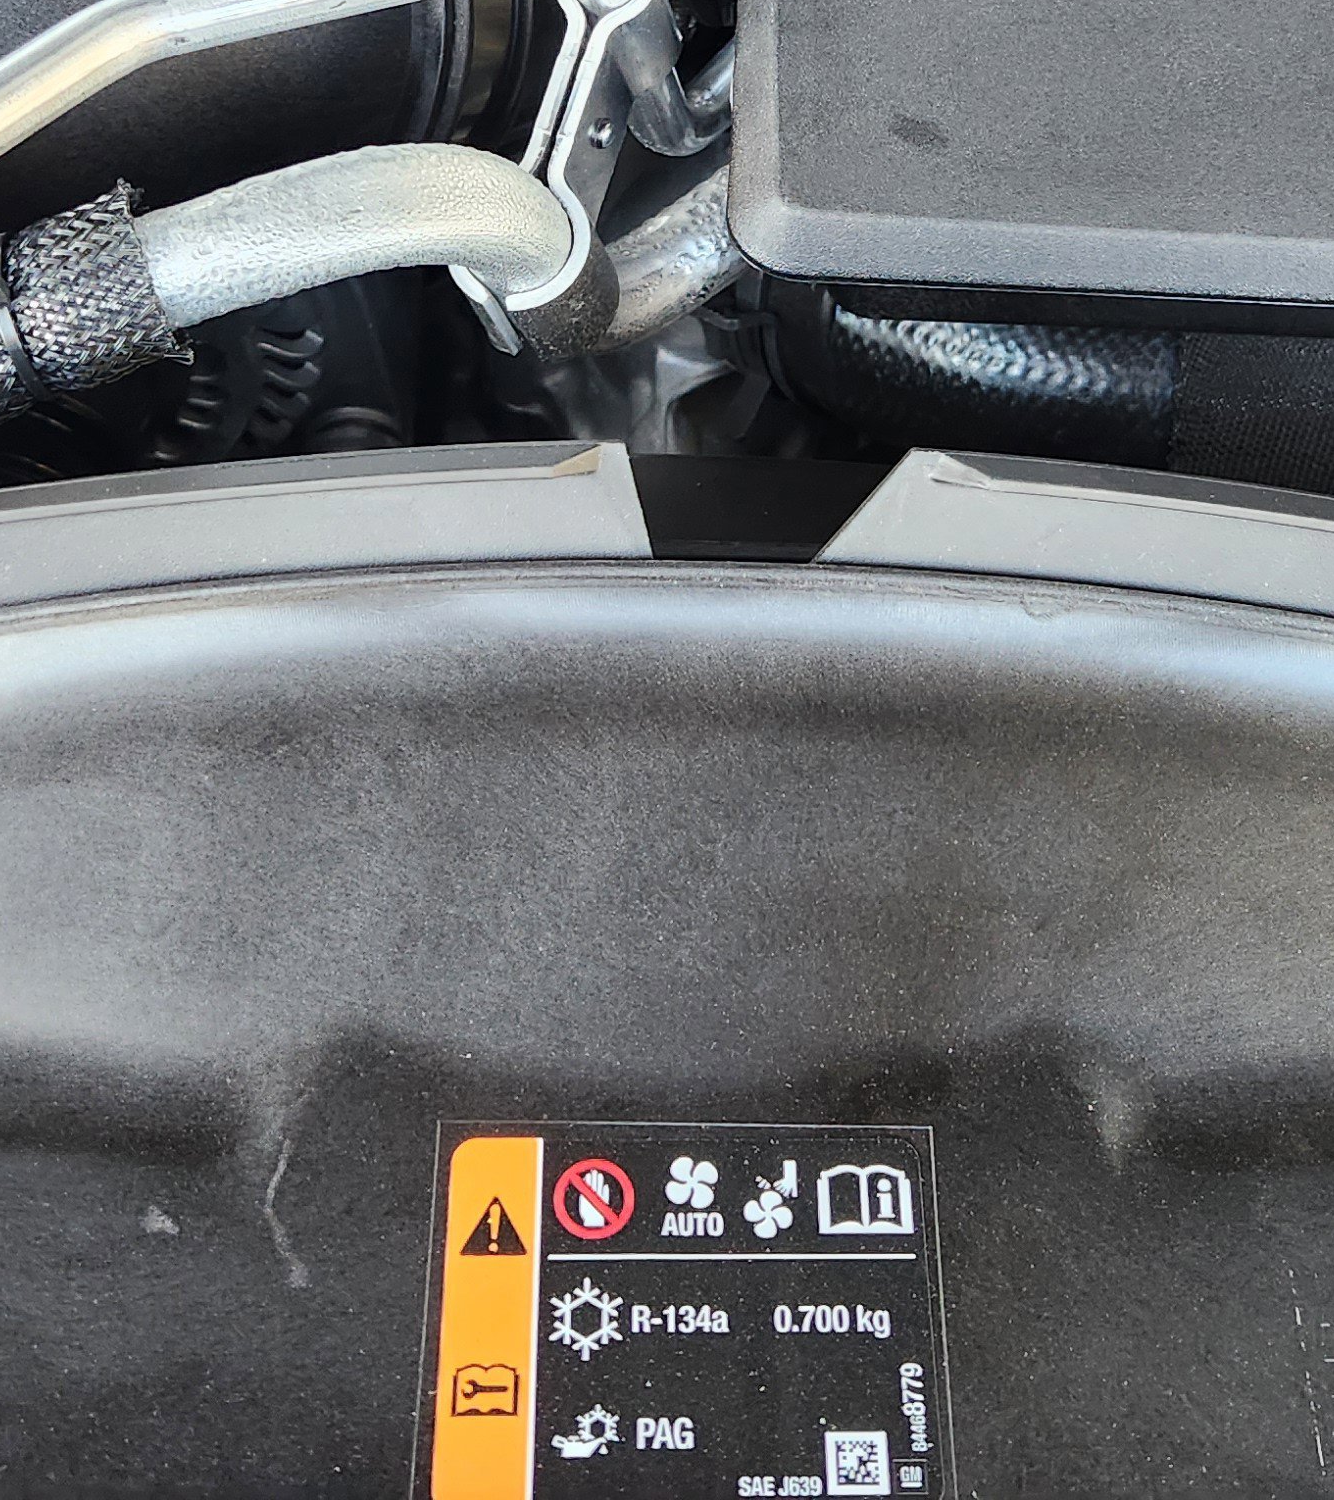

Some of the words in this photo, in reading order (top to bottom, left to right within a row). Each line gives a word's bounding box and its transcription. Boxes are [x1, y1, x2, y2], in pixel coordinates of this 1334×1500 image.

[660, 1211, 725, 1238] AUTO
[629, 1304, 730, 1335] R-134a
[773, 1304, 850, 1335] 0.700
[854, 1303, 892, 1338] kg
[635, 1416, 696, 1451] PAG
[737, 1475, 777, 1497] SAE
[777, 1475, 823, 1497] J639
[899, 1465, 923, 1482] GM
